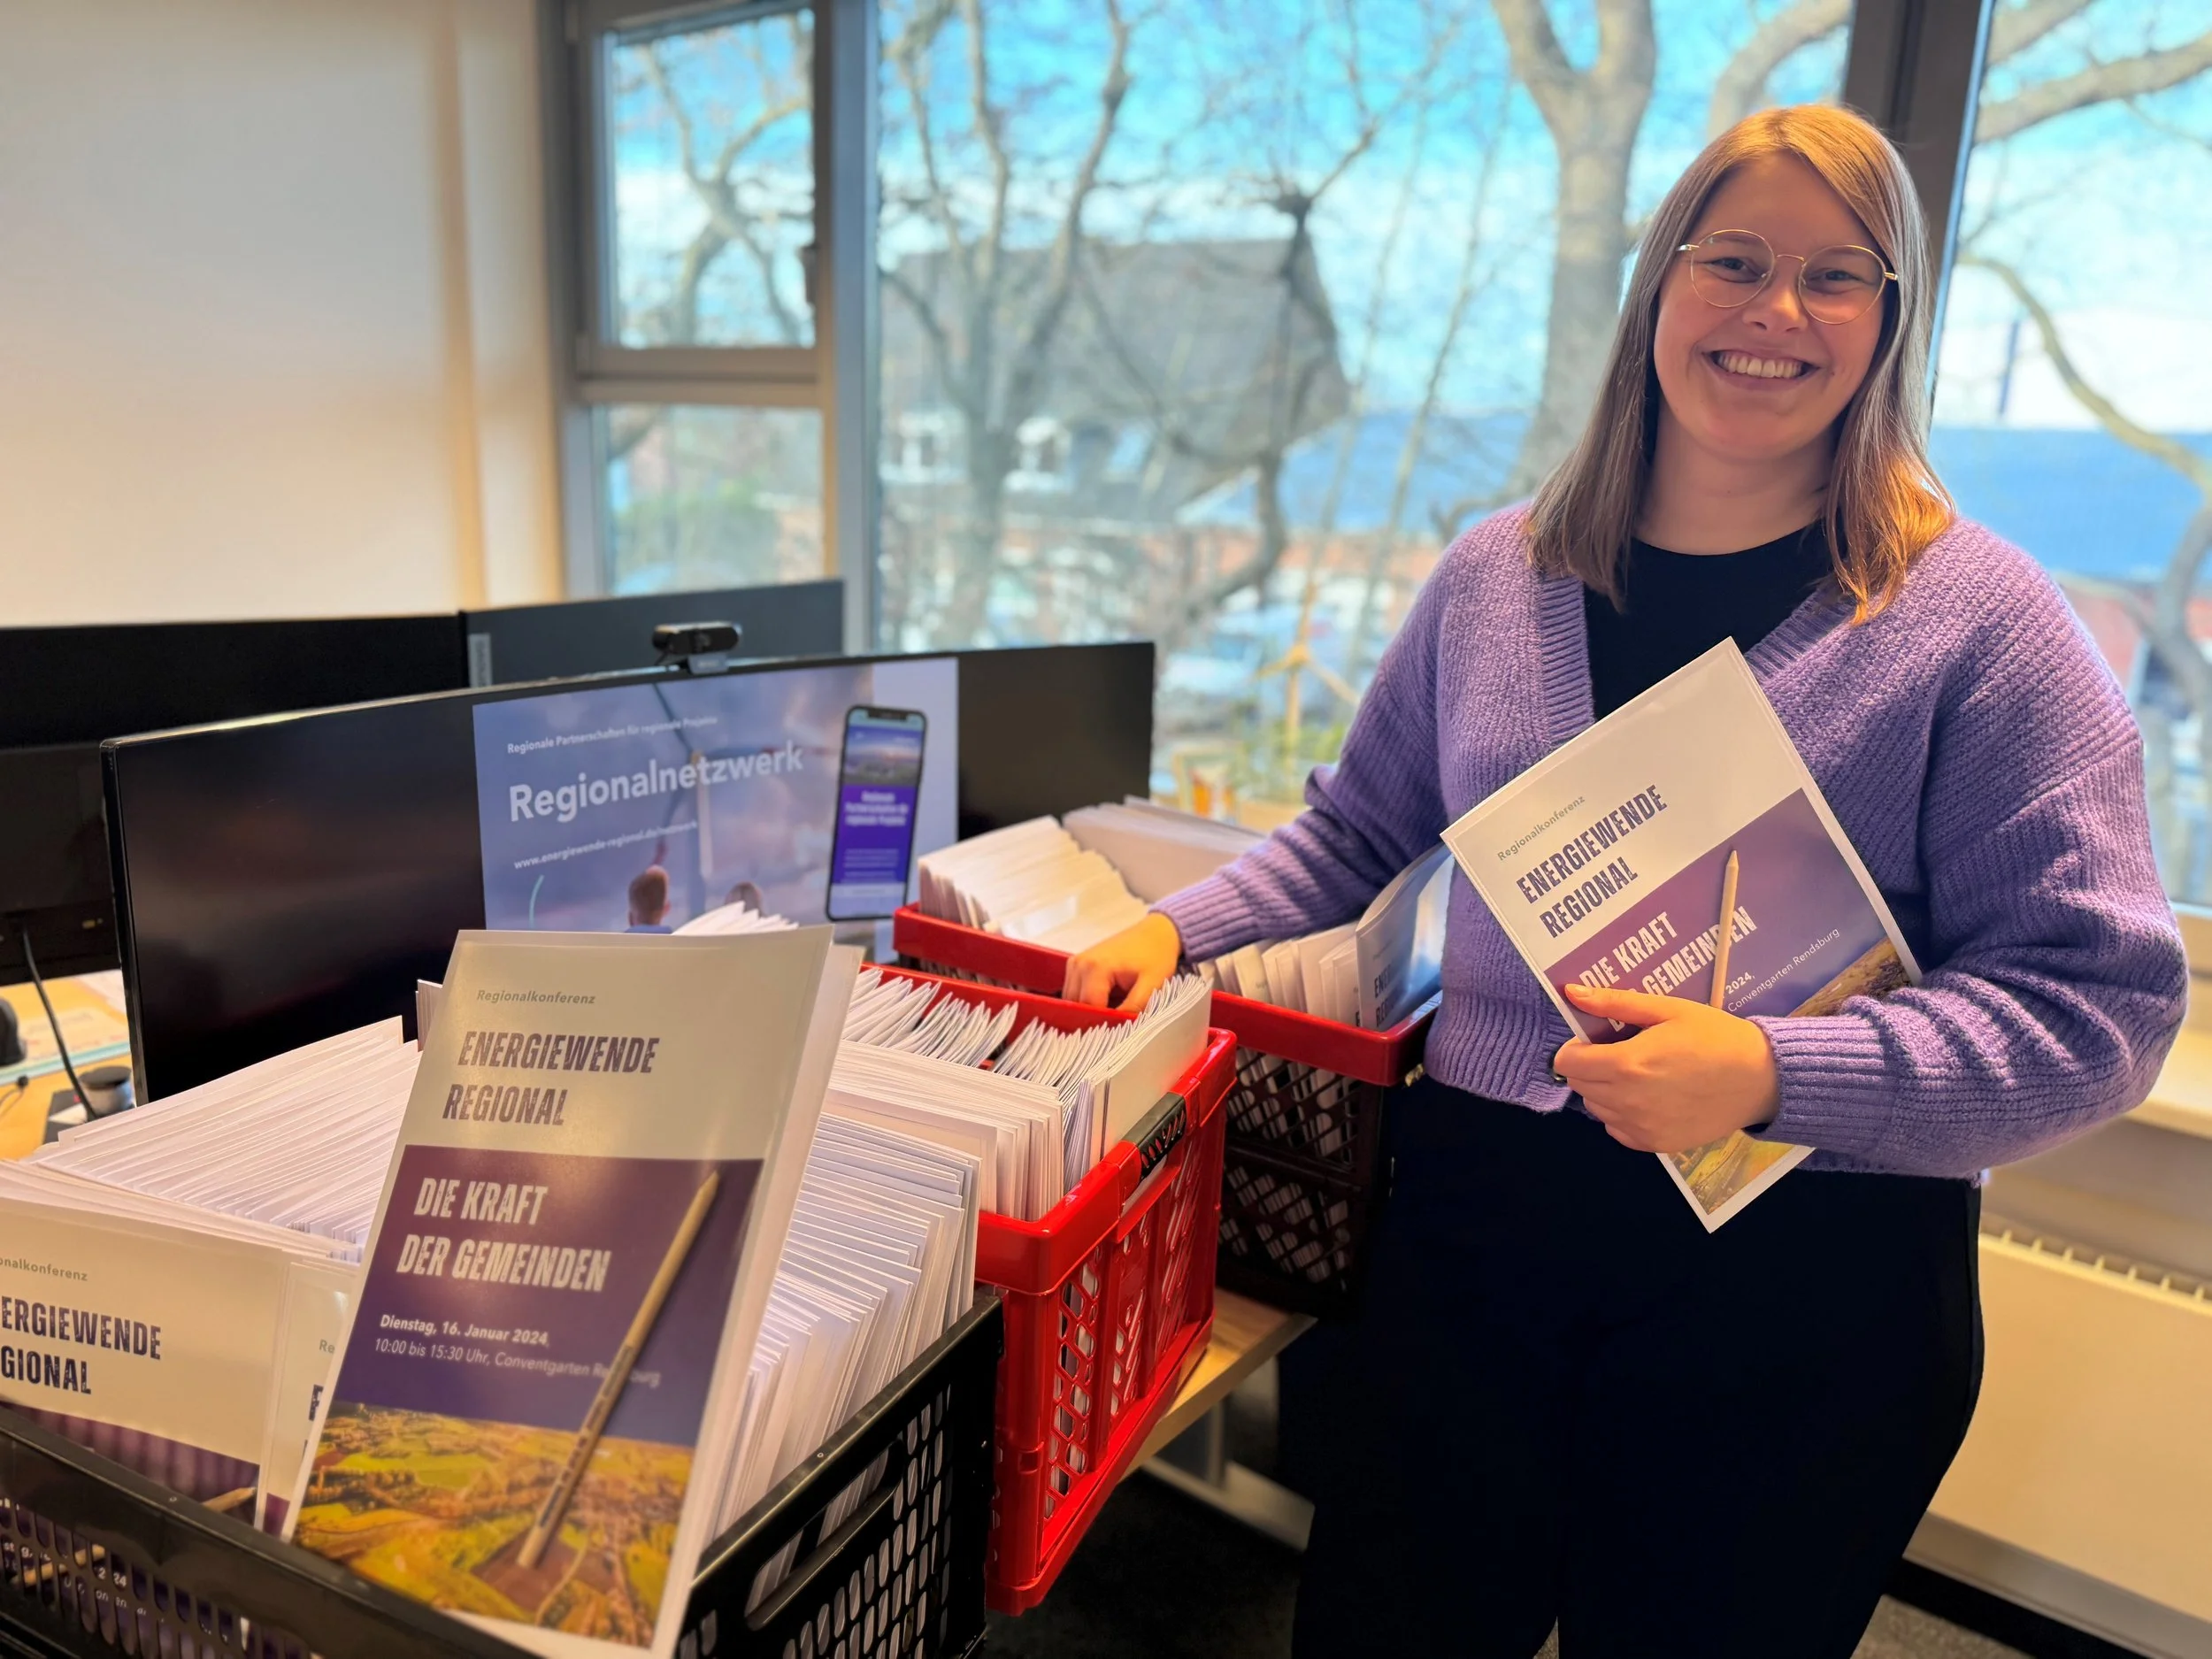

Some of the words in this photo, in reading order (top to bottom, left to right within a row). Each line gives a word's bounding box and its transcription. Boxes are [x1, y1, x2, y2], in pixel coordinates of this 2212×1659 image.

[507, 736, 555, 755] Regionale
[556, 725, 626, 746] Partnerschaften
[509, 740, 803, 823] Regionalnetzwerk
[1497, 794, 1586, 861] Regionalkonferenz
[1516, 784, 1668, 905] ENERGIEWENDE
[1540, 855, 1639, 939] REGIONAL
[1579, 956, 1621, 988] DIE
[1613, 911, 1678, 974] KRAFT
[1727, 964, 1793, 1013] Conventgarten
[1793, 927, 1840, 966] Rendsburg
[476, 988, 596, 1006] Regionalkonferenz
[1725, 972, 1755, 995] 2024,
[457, 1030, 660, 1074] ENERGIEWENDE
[442, 1083, 569, 1126] REGIONAL
[414, 1177, 461, 1219] DIE
[461, 1181, 549, 1225] KRAFT
[396, 1233, 450, 1278] DER
[452, 1238, 611, 1293] GEMEINDEN
[1, 1294, 161, 1361] ERGIEWENDE
[380, 1314, 437, 1336] Dienstag,
[442, 1321, 460, 1336] 16.
[465, 1324, 510, 1341] Januar
[1, 1344, 91, 1395] GIONAL
[374, 1337, 406, 1355] 10:00
[409, 1340, 426, 1357] bis
[431, 1343, 463, 1362] 15:30
[465, 1346, 490, 1366] Uhr,
[495, 1351, 589, 1378] Conventgarten
